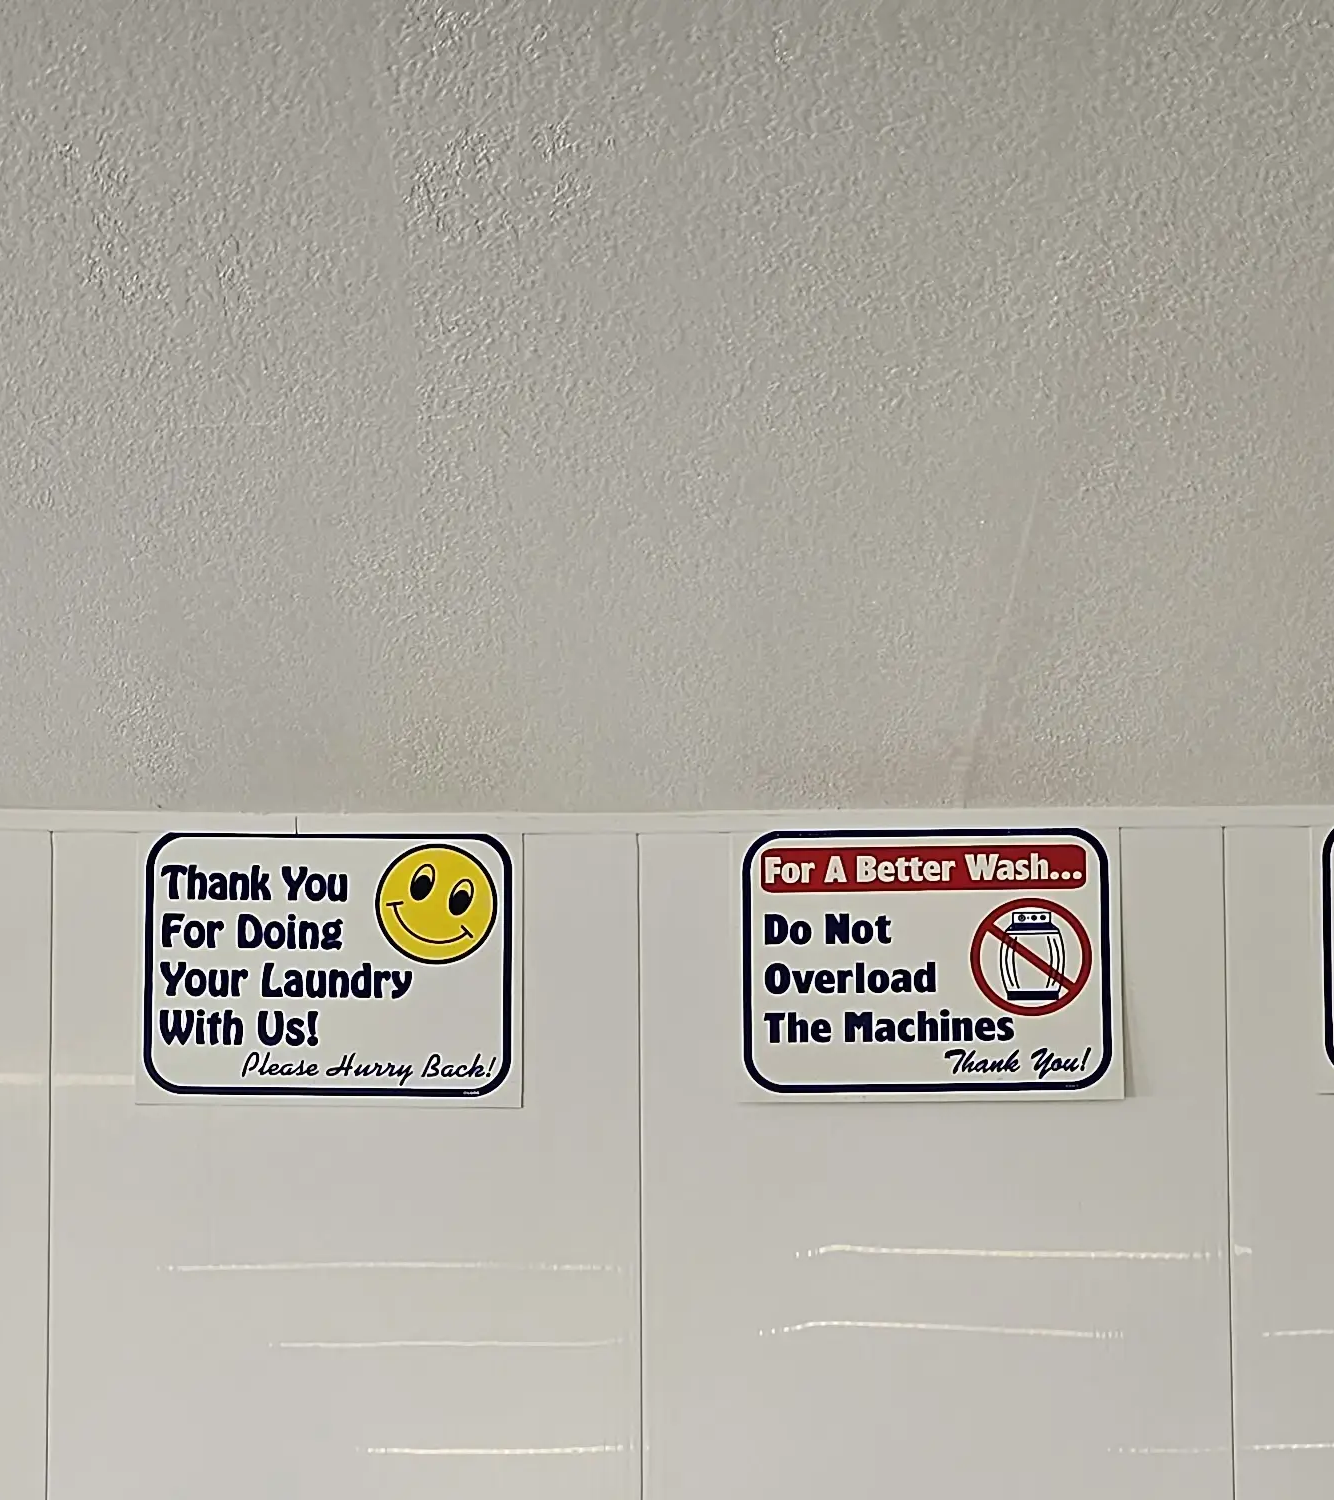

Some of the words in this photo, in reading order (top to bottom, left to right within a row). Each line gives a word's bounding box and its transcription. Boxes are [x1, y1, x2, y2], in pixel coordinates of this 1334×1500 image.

[161, 864, 270, 901] Thank
[281, 866, 348, 902] You
[765, 857, 815, 884] For
[824, 856, 847, 883] A
[857, 855, 955, 882] Better
[966, 853, 1082, 881] Wash...
[162, 913, 224, 949] For
[237, 914, 343, 950] Doing
[764, 914, 812, 945] Do
[825, 914, 892, 944] Not
[160, 961, 248, 997] Your
[261, 963, 413, 999] Laundry
[764, 962, 936, 994] Overload
[159, 1009, 244, 1046] With
[257, 1011, 319, 1046] Us!
[764, 1012, 831, 1043] The
[845, 1010, 1014, 1043] Machines
[242, 1052, 319, 1078] Please
[327, 1053, 413, 1086] Hurry
[421, 1053, 497, 1079] Back!
[944, 1049, 1021, 1075] Thank
[1031, 1048, 1091, 1079] You!
